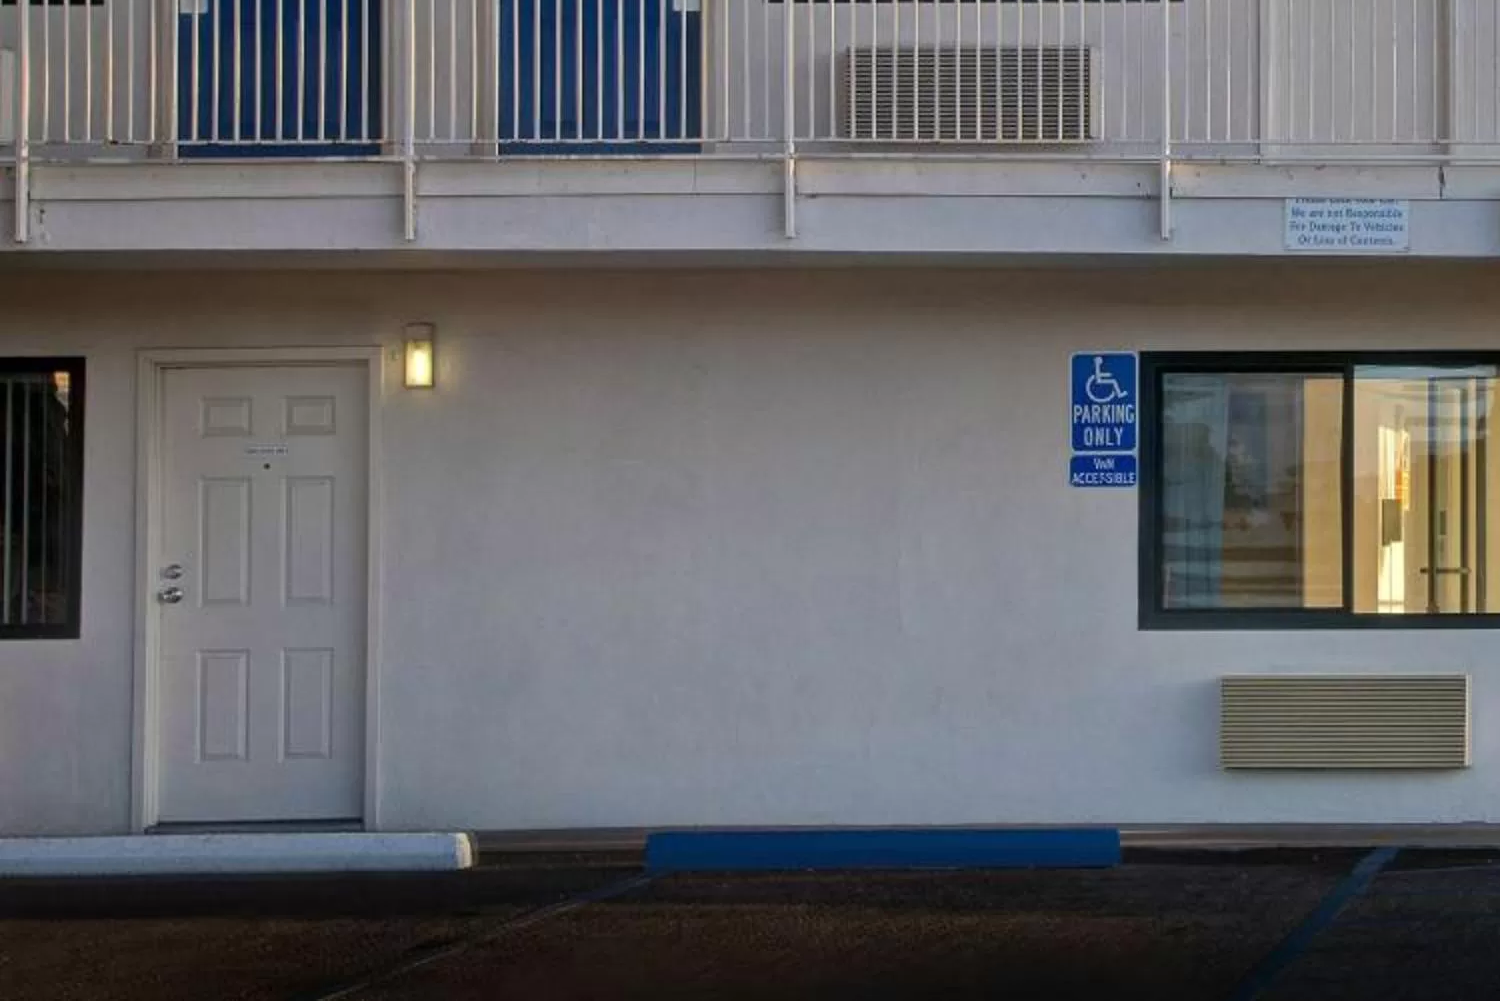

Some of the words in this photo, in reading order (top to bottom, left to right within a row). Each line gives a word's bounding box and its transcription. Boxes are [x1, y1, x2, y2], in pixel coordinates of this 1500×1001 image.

[1073, 404, 1135, 424] PARKING
[1083, 426, 1123, 447] ONLY
[1071, 472, 1136, 484] ACCESSIBLE
